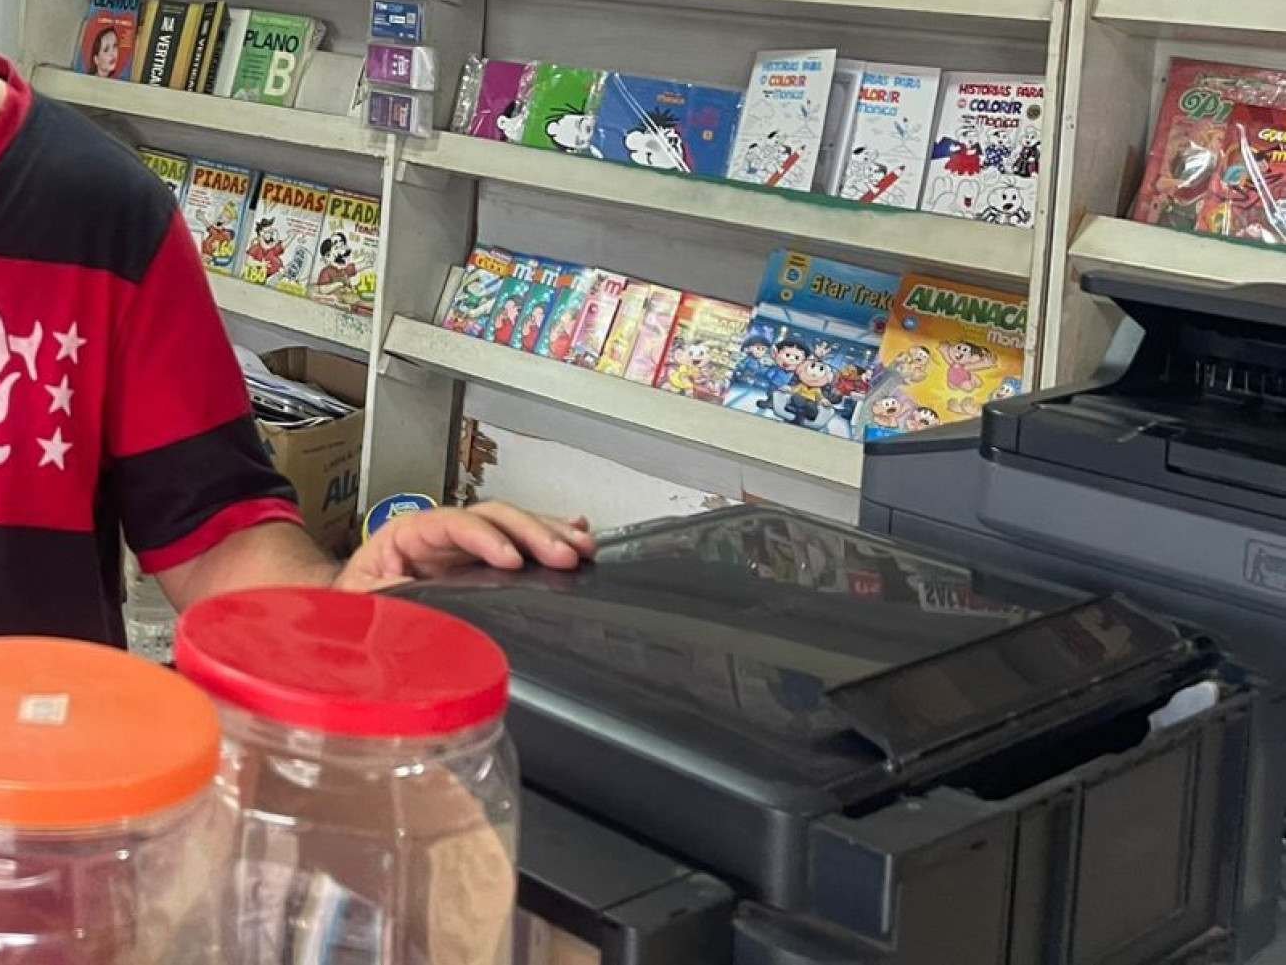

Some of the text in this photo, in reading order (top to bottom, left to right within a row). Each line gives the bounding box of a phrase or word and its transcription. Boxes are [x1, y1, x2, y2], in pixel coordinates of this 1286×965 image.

[245, 29, 300, 53] PLANO
[265, 50, 296, 96] B
[193, 168, 247, 195] PIADAS
[263, 183, 325, 212] PIADAS
